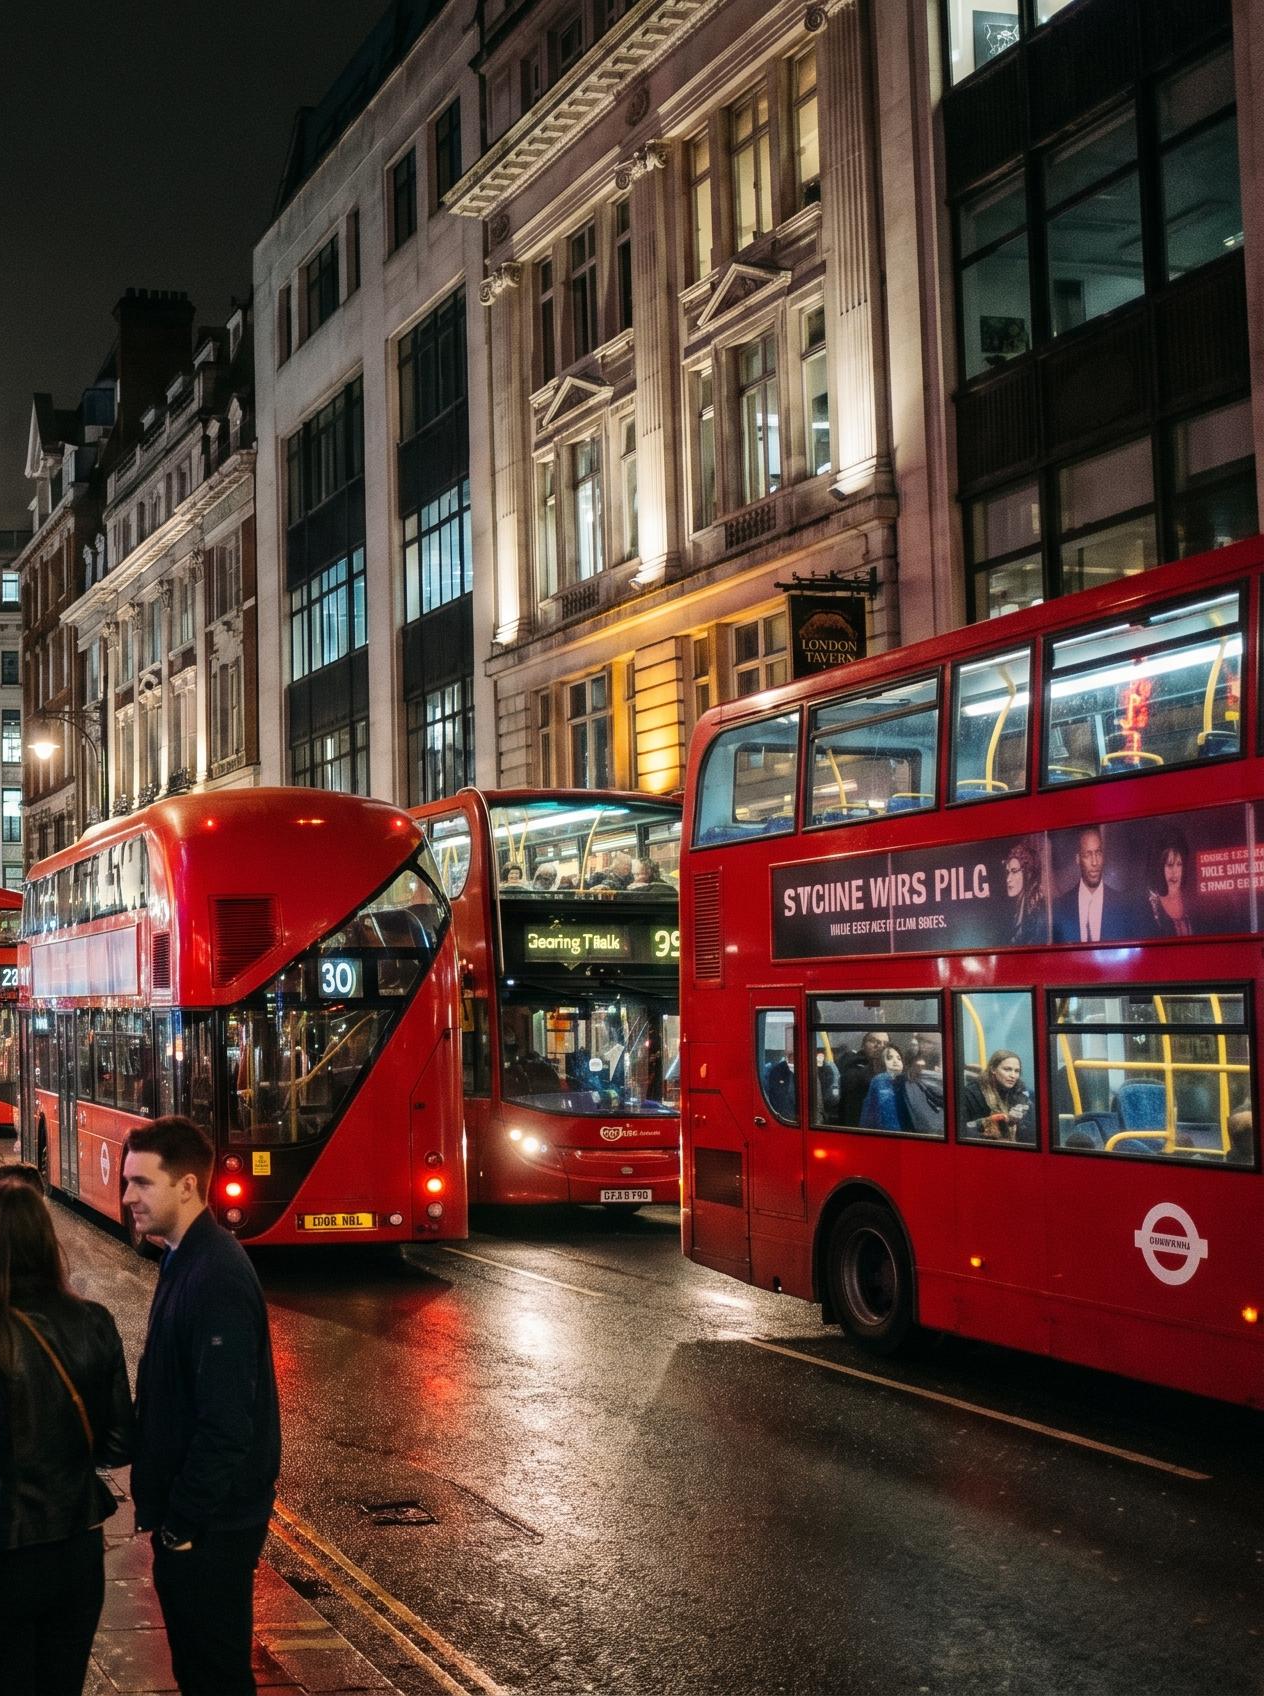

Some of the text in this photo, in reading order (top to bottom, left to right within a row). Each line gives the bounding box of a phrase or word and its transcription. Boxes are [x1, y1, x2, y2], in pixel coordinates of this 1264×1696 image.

[801, 639, 856, 652] LONDON
[805, 652, 856, 664] TAVERN
[321, 962, 353, 993] 30
